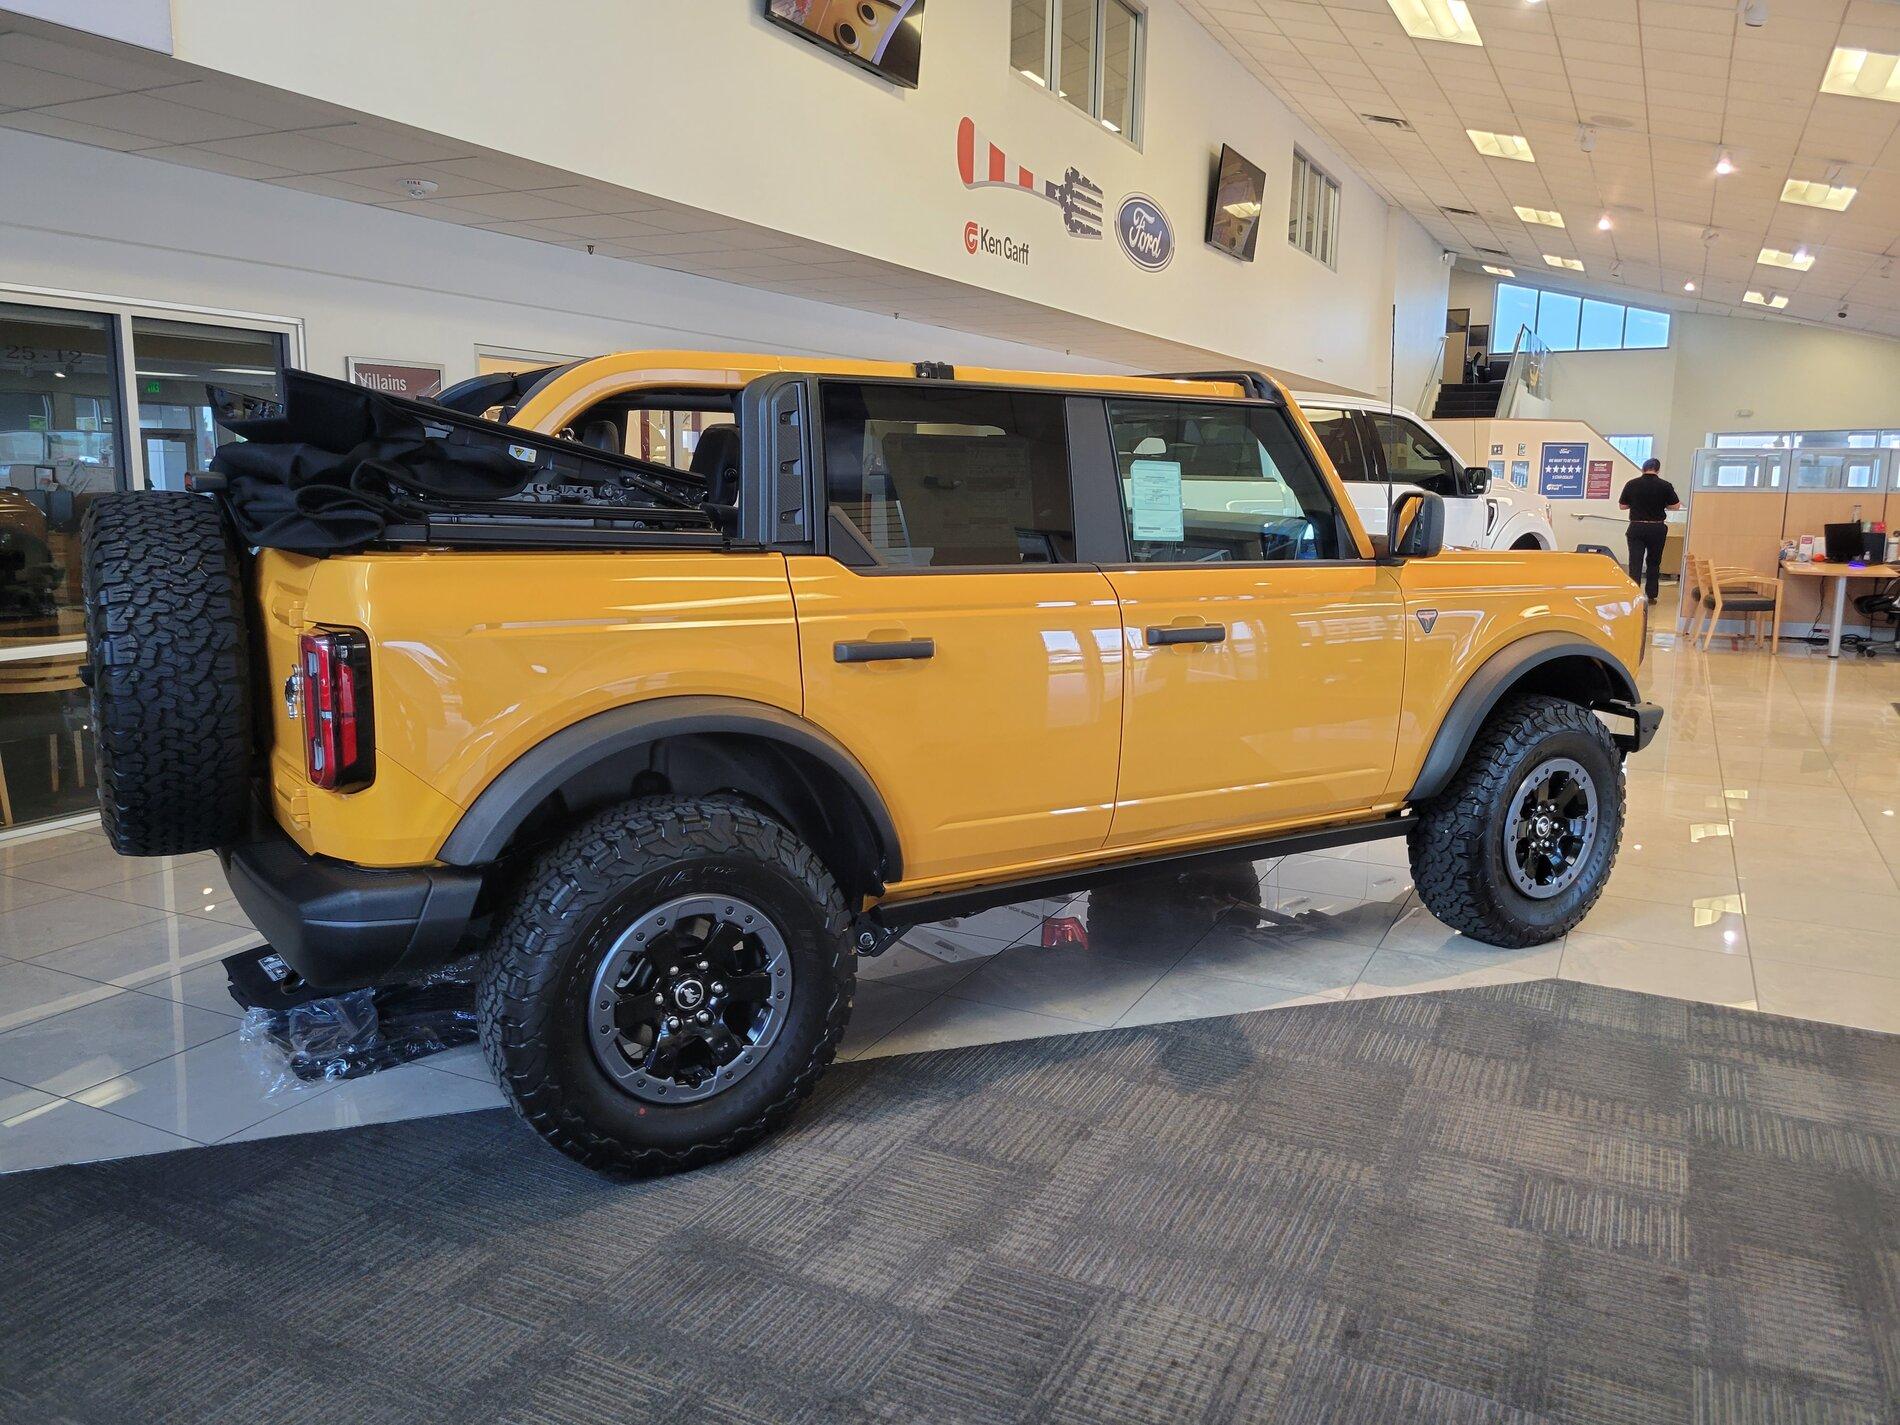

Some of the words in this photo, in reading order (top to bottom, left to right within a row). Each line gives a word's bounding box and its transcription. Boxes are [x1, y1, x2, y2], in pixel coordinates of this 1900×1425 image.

[980, 226, 1002, 257] Ken
[1003, 236, 1029, 266] Garff
[1129, 207, 1162, 259] Ford
[359, 372, 407, 391] Villains
